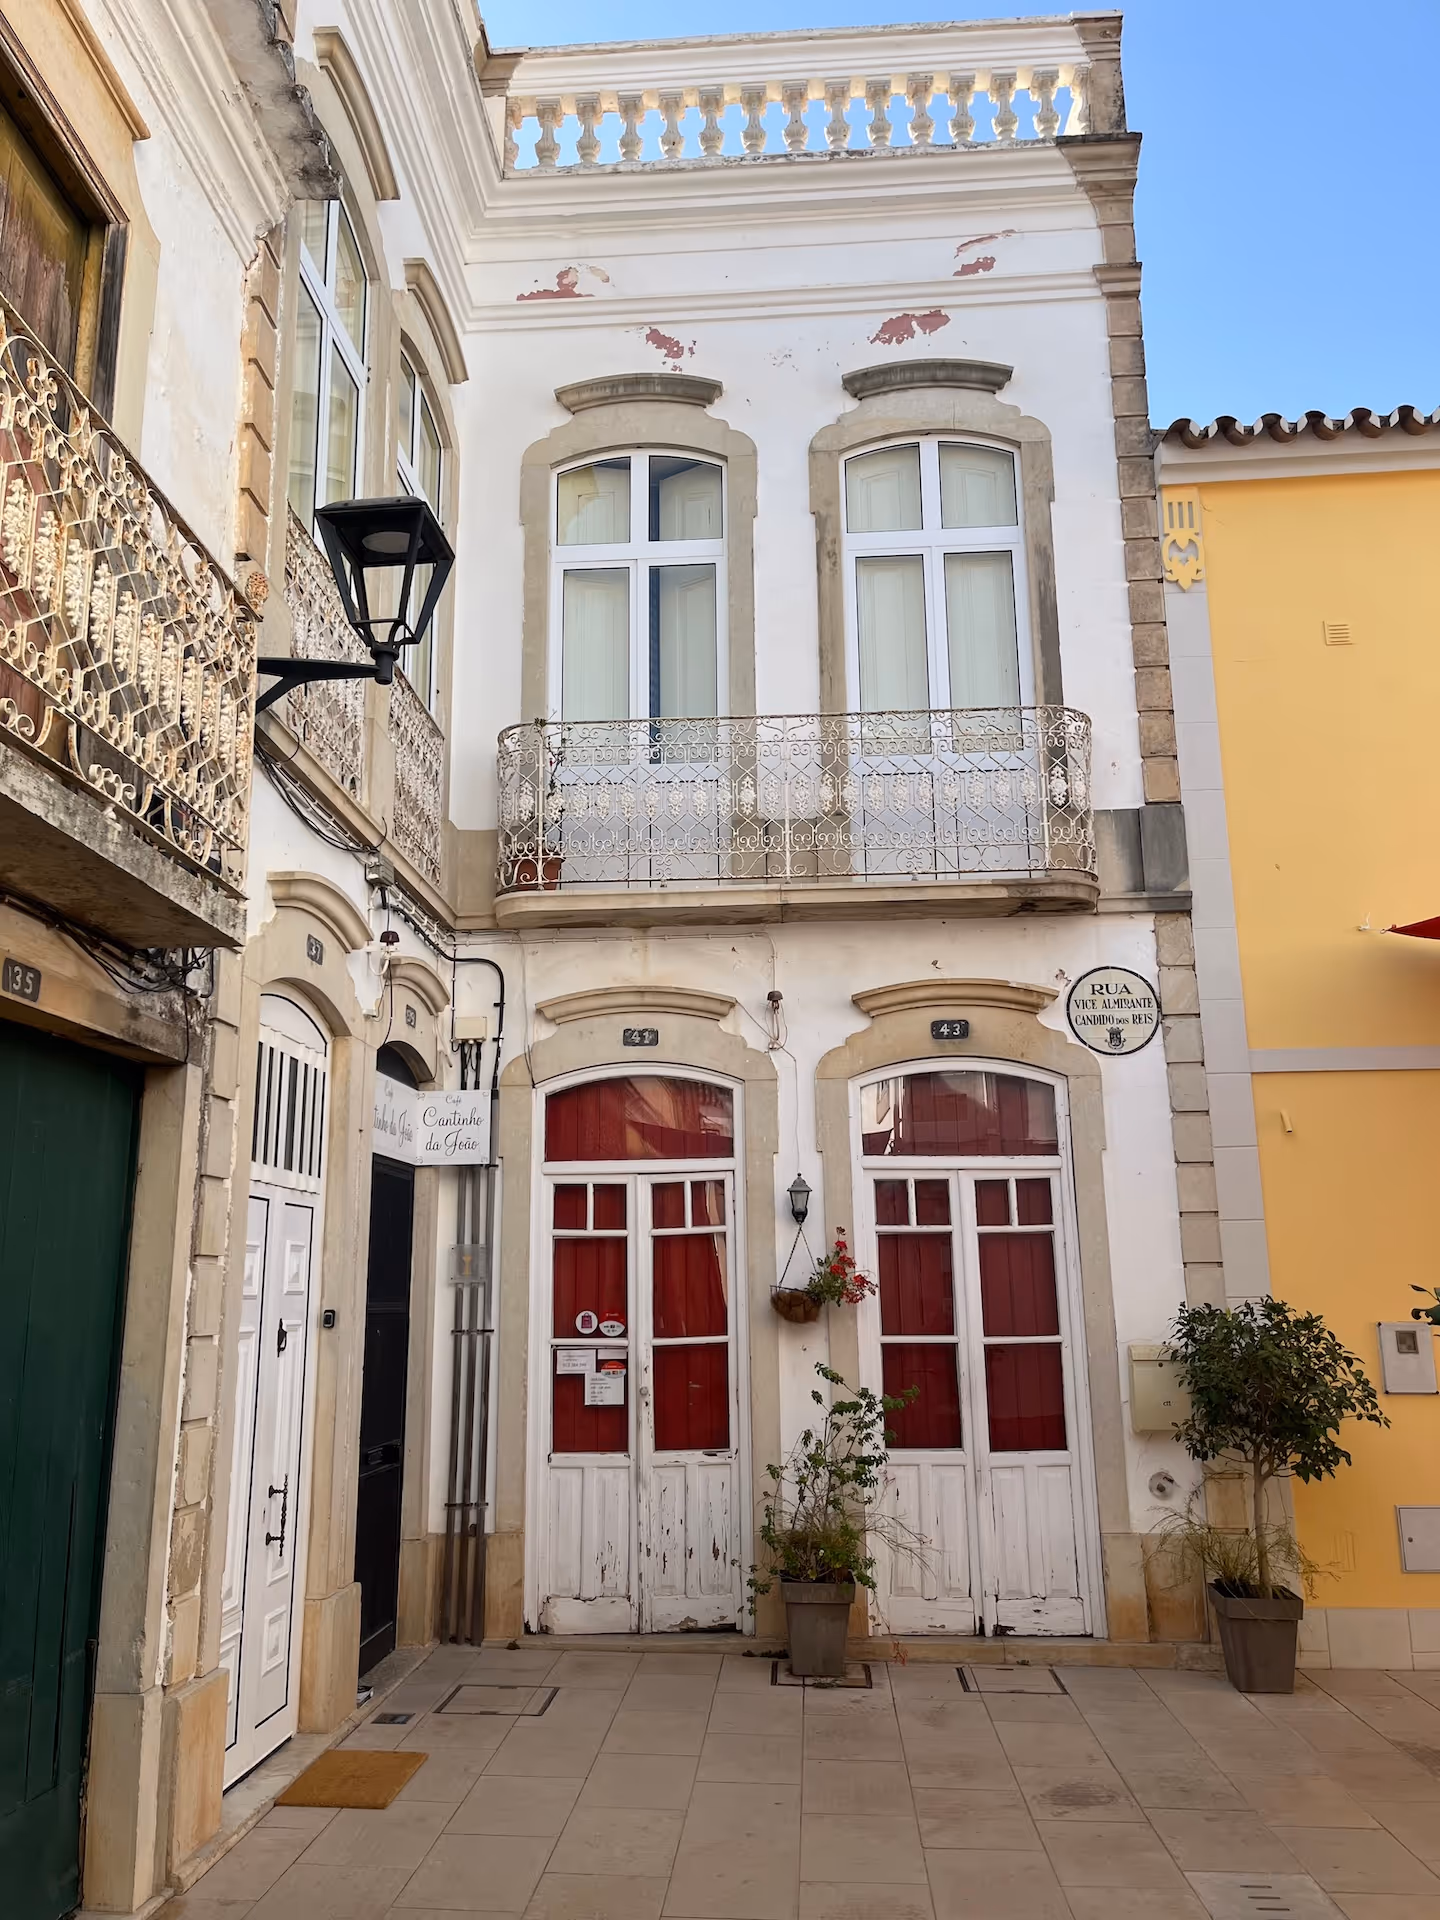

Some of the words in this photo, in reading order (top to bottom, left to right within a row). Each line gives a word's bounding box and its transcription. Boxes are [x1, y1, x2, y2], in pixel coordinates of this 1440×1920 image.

[1090, 983, 1133, 996] RUA
[1074, 999, 1098, 1010] VICE
[1101, 997, 1154, 1010] ALMIRANTE
[1075, 1014, 1114, 1026] CANDIDO
[1132, 1013, 1154, 1026] REIS
[939, 1023, 961, 1036] 43
[630, 1031, 650, 1044] 41
[422, 1106, 484, 1127] Cantinho
[425, 1132, 442, 1151] da
[444, 1129, 480, 1156] João
